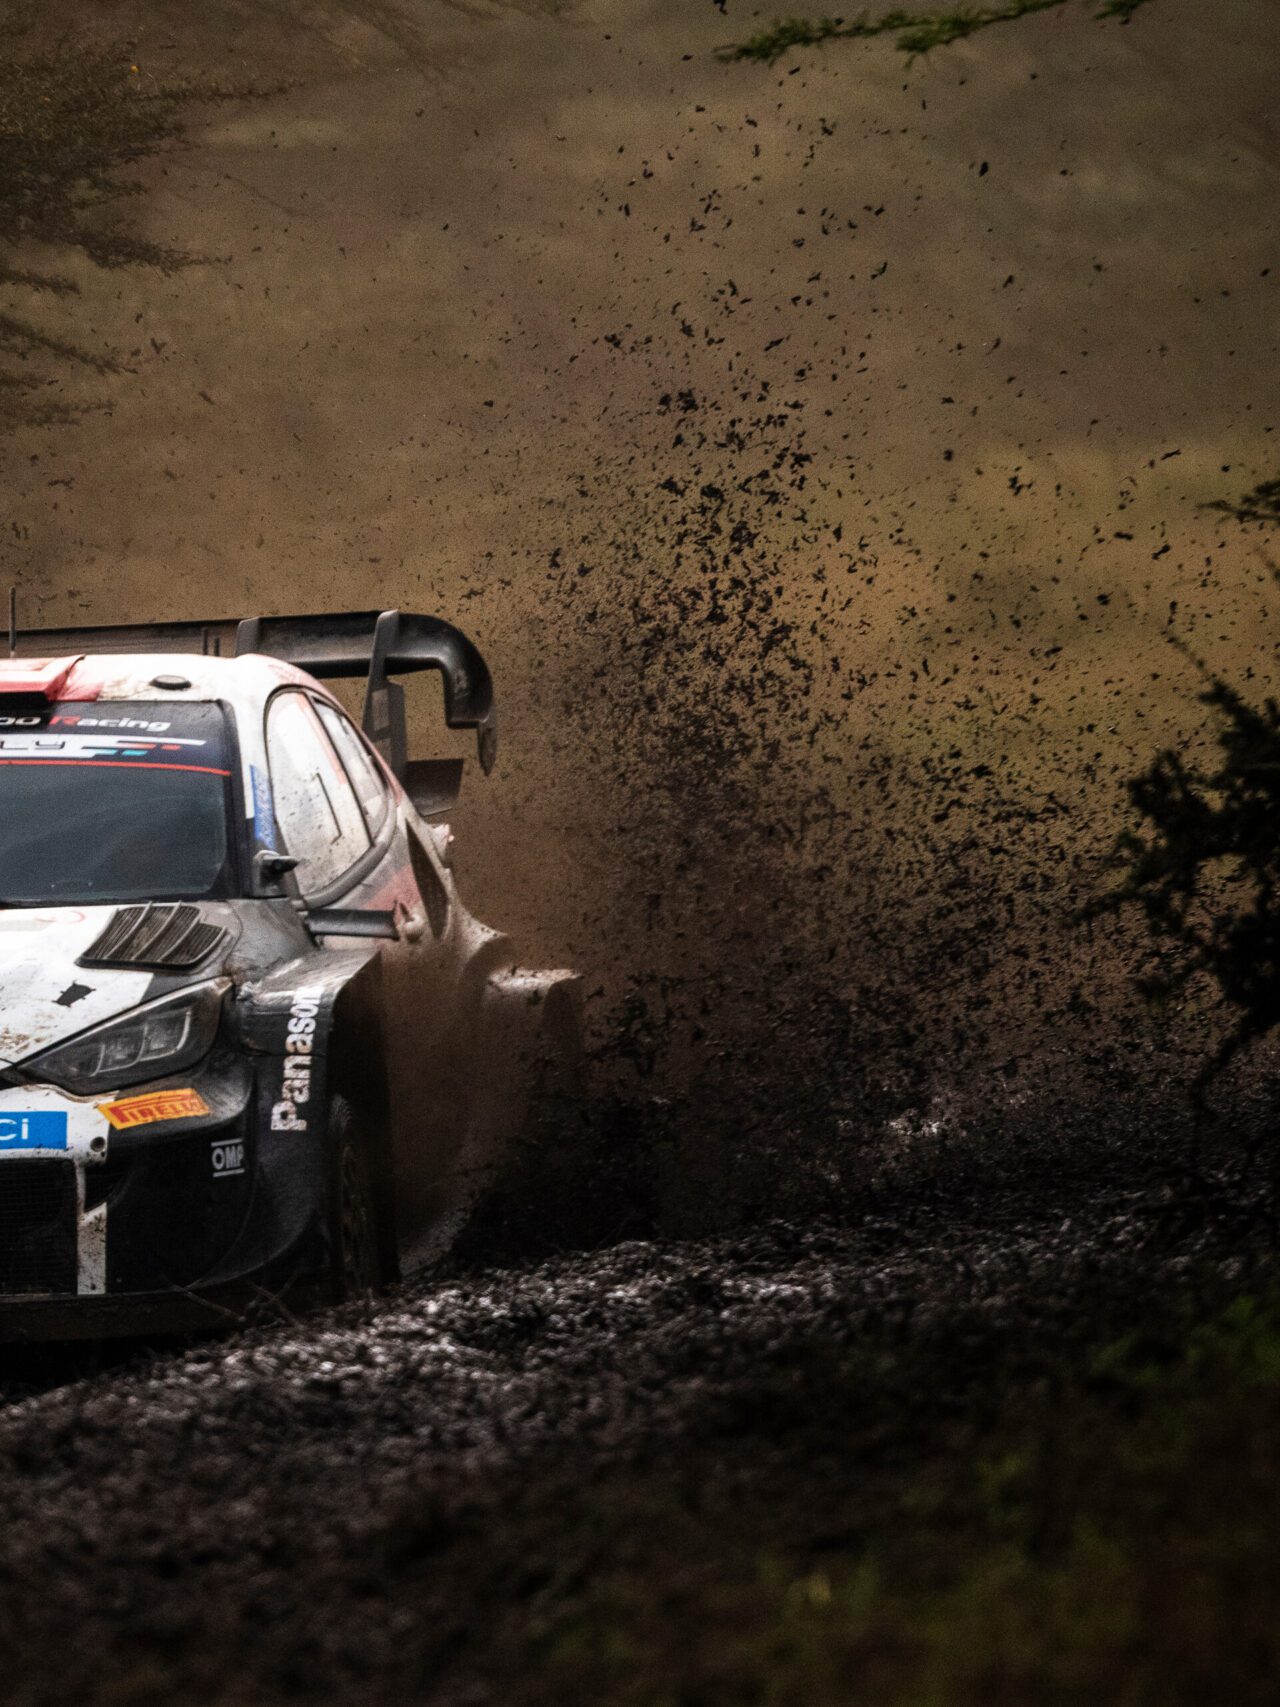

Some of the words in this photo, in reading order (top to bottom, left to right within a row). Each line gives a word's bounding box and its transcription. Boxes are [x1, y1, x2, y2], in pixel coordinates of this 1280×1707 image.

[49, 715, 170, 732] Racing
[271, 986, 325, 1130] Panason
[212, 1146, 244, 1169] OMP
